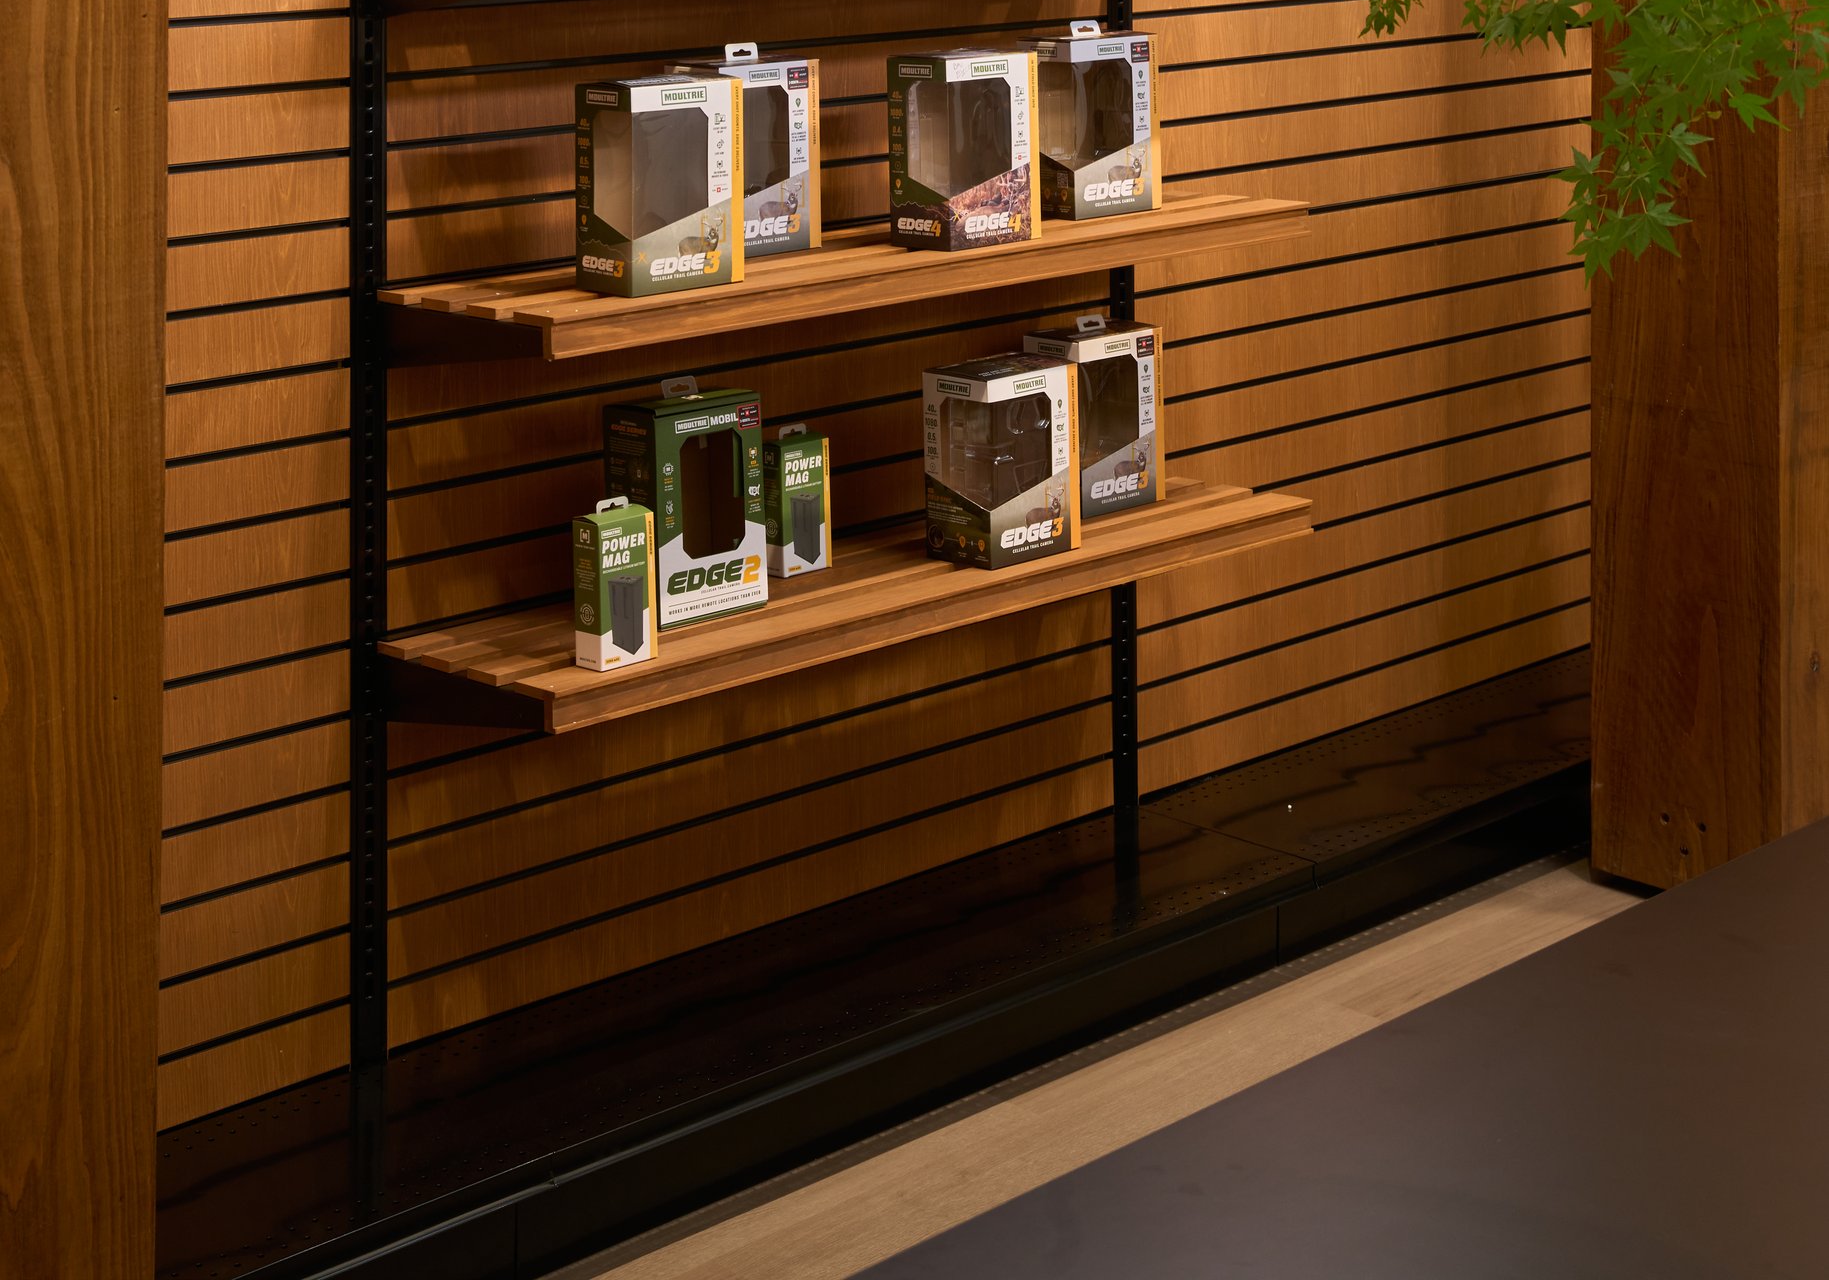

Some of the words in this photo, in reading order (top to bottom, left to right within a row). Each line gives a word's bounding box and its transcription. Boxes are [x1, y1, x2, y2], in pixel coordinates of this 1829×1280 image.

[901, 67, 930, 75] MOULTRIE
[973, 63, 1006, 73] MOULTRIE
[588, 92, 616, 102] MOULTRIE
[664, 90, 704, 102] MOULTRIE
[1084, 177, 1145, 201] EDGE3
[744, 214, 800, 238] DGE3
[897, 217, 941, 237] EDGE4
[964, 211, 1022, 233] EDGE4
[582, 255, 624, 277] EDGE3
[650, 250, 721, 276] EDGE3
[1106, 342, 1129, 350] MOULTRIE
[939, 381, 968, 393] MOULTRIE
[1016, 379, 1044, 390] MOULTRIE
[677, 420, 707, 430] MOULTRIE
[710, 413, 739, 426] MOBIL
[785, 455, 822, 474] POWER
[785, 471, 809, 487] MAG
[1090, 471, 1149, 499] EDGE3
[1000, 517, 1064, 548] EDGE3
[602, 532, 645, 554] POWER
[602, 550, 630, 568] MAG
[667, 554, 761, 595] EDGE2
[718, 596, 739, 604] LOCATIONS
